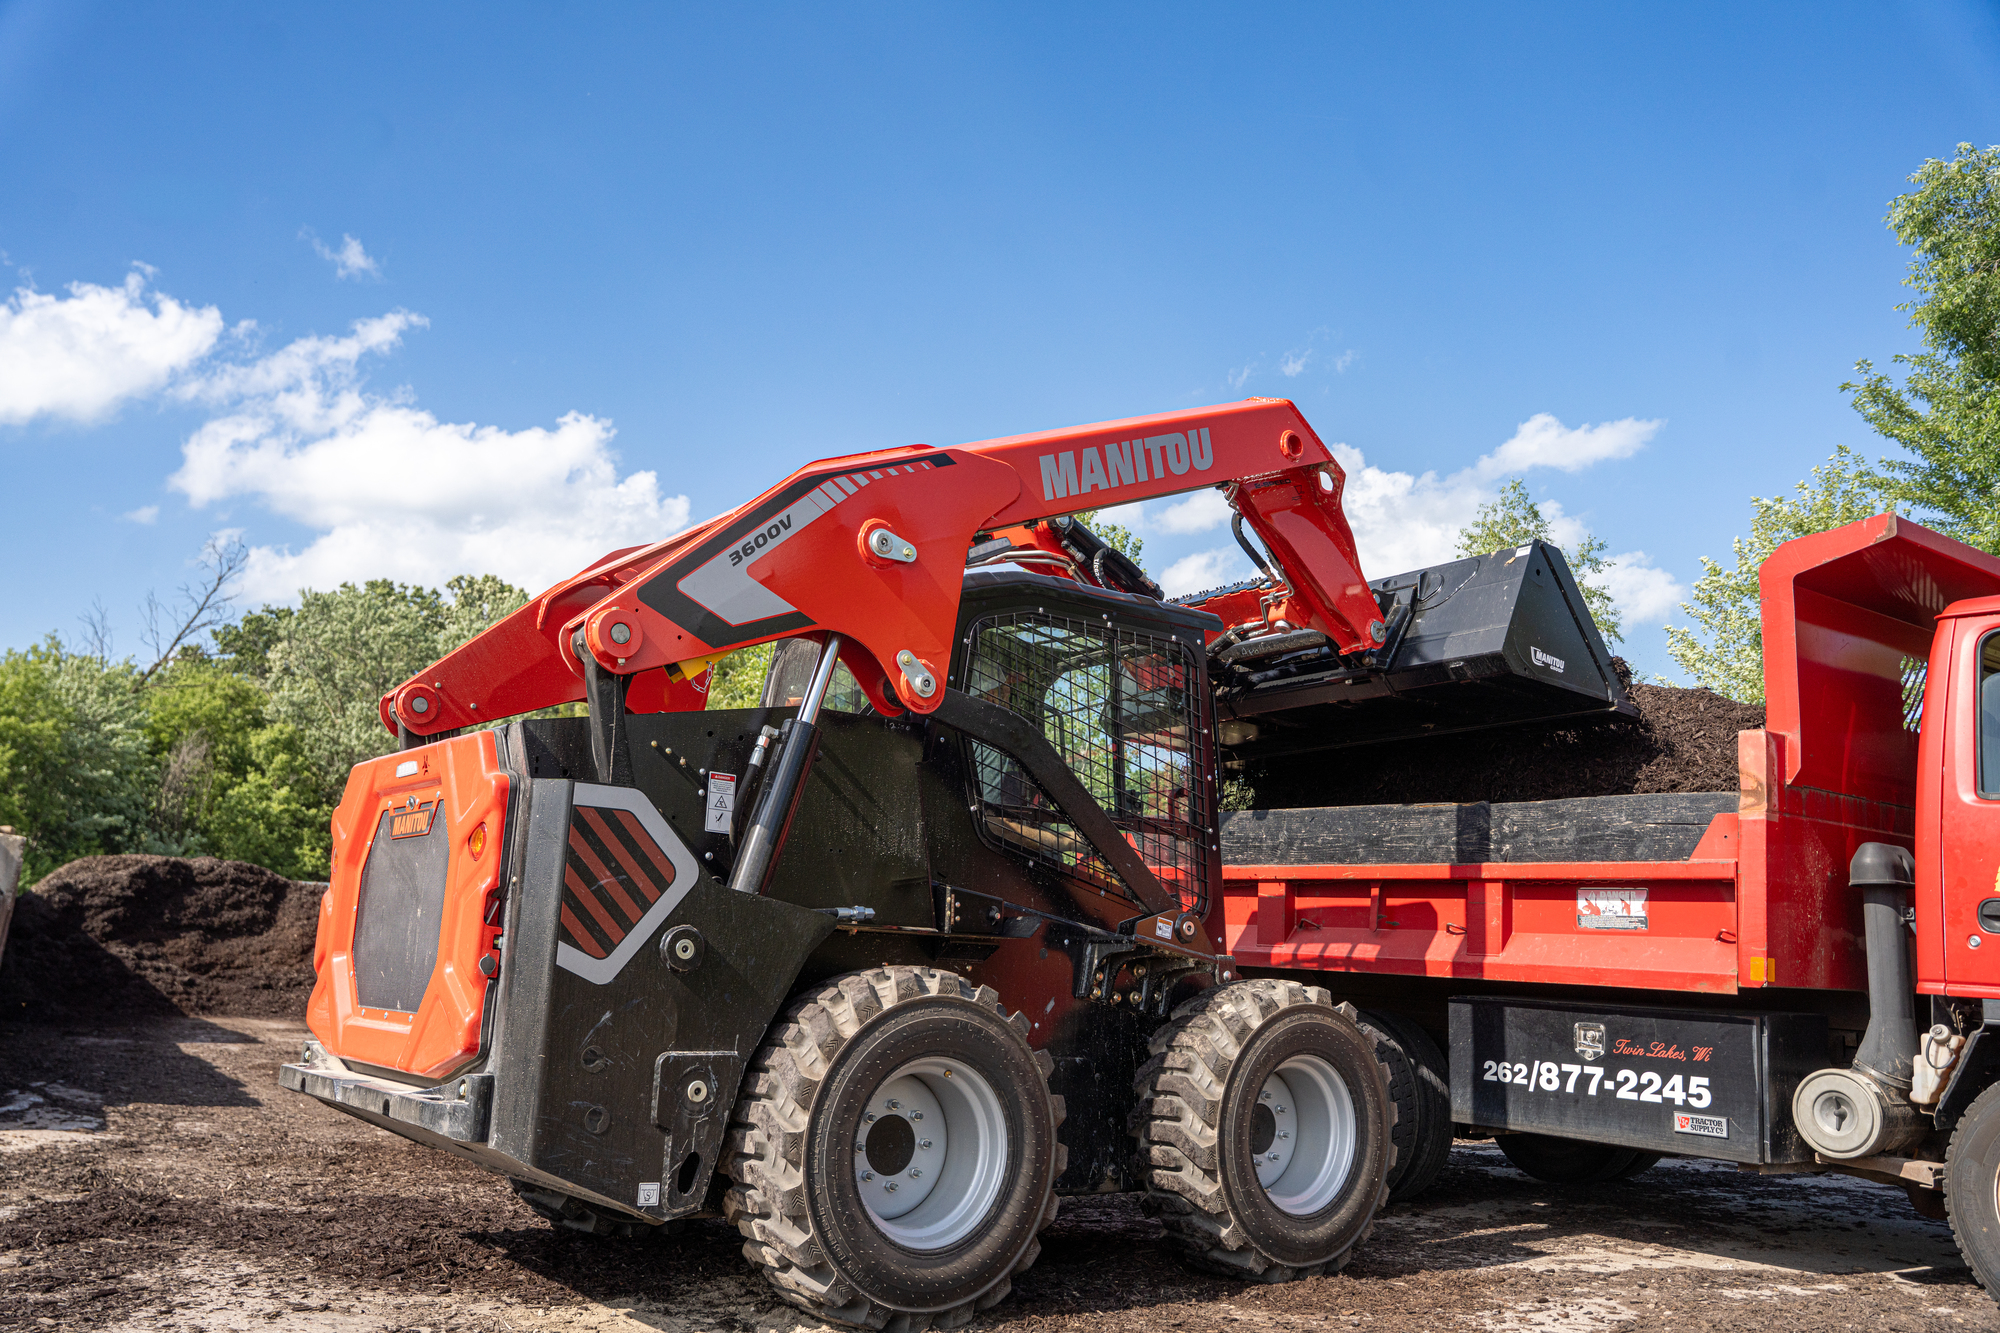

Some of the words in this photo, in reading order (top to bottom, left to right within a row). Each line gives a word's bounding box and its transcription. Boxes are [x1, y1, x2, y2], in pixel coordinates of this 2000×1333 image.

[1039, 427, 1214, 501] MANITOU
[729, 514, 792, 567] 3600V
[1536, 650, 1565, 669] MANITOU
[392, 811, 430, 835] MANITOU
[1599, 891, 1636, 899] DANGER
[1613, 1039, 1645, 1056] Twin
[1646, 1042, 1687, 1062] Lakes,
[1692, 1046, 1714, 1062] Wi
[1483, 1060, 1712, 1109] 262/877-2245
[1679, 1116, 1689, 1128] TSC
[1690, 1117, 1723, 1127] TRACTOR
[1690, 1124, 1714, 1134] SUPPLY
